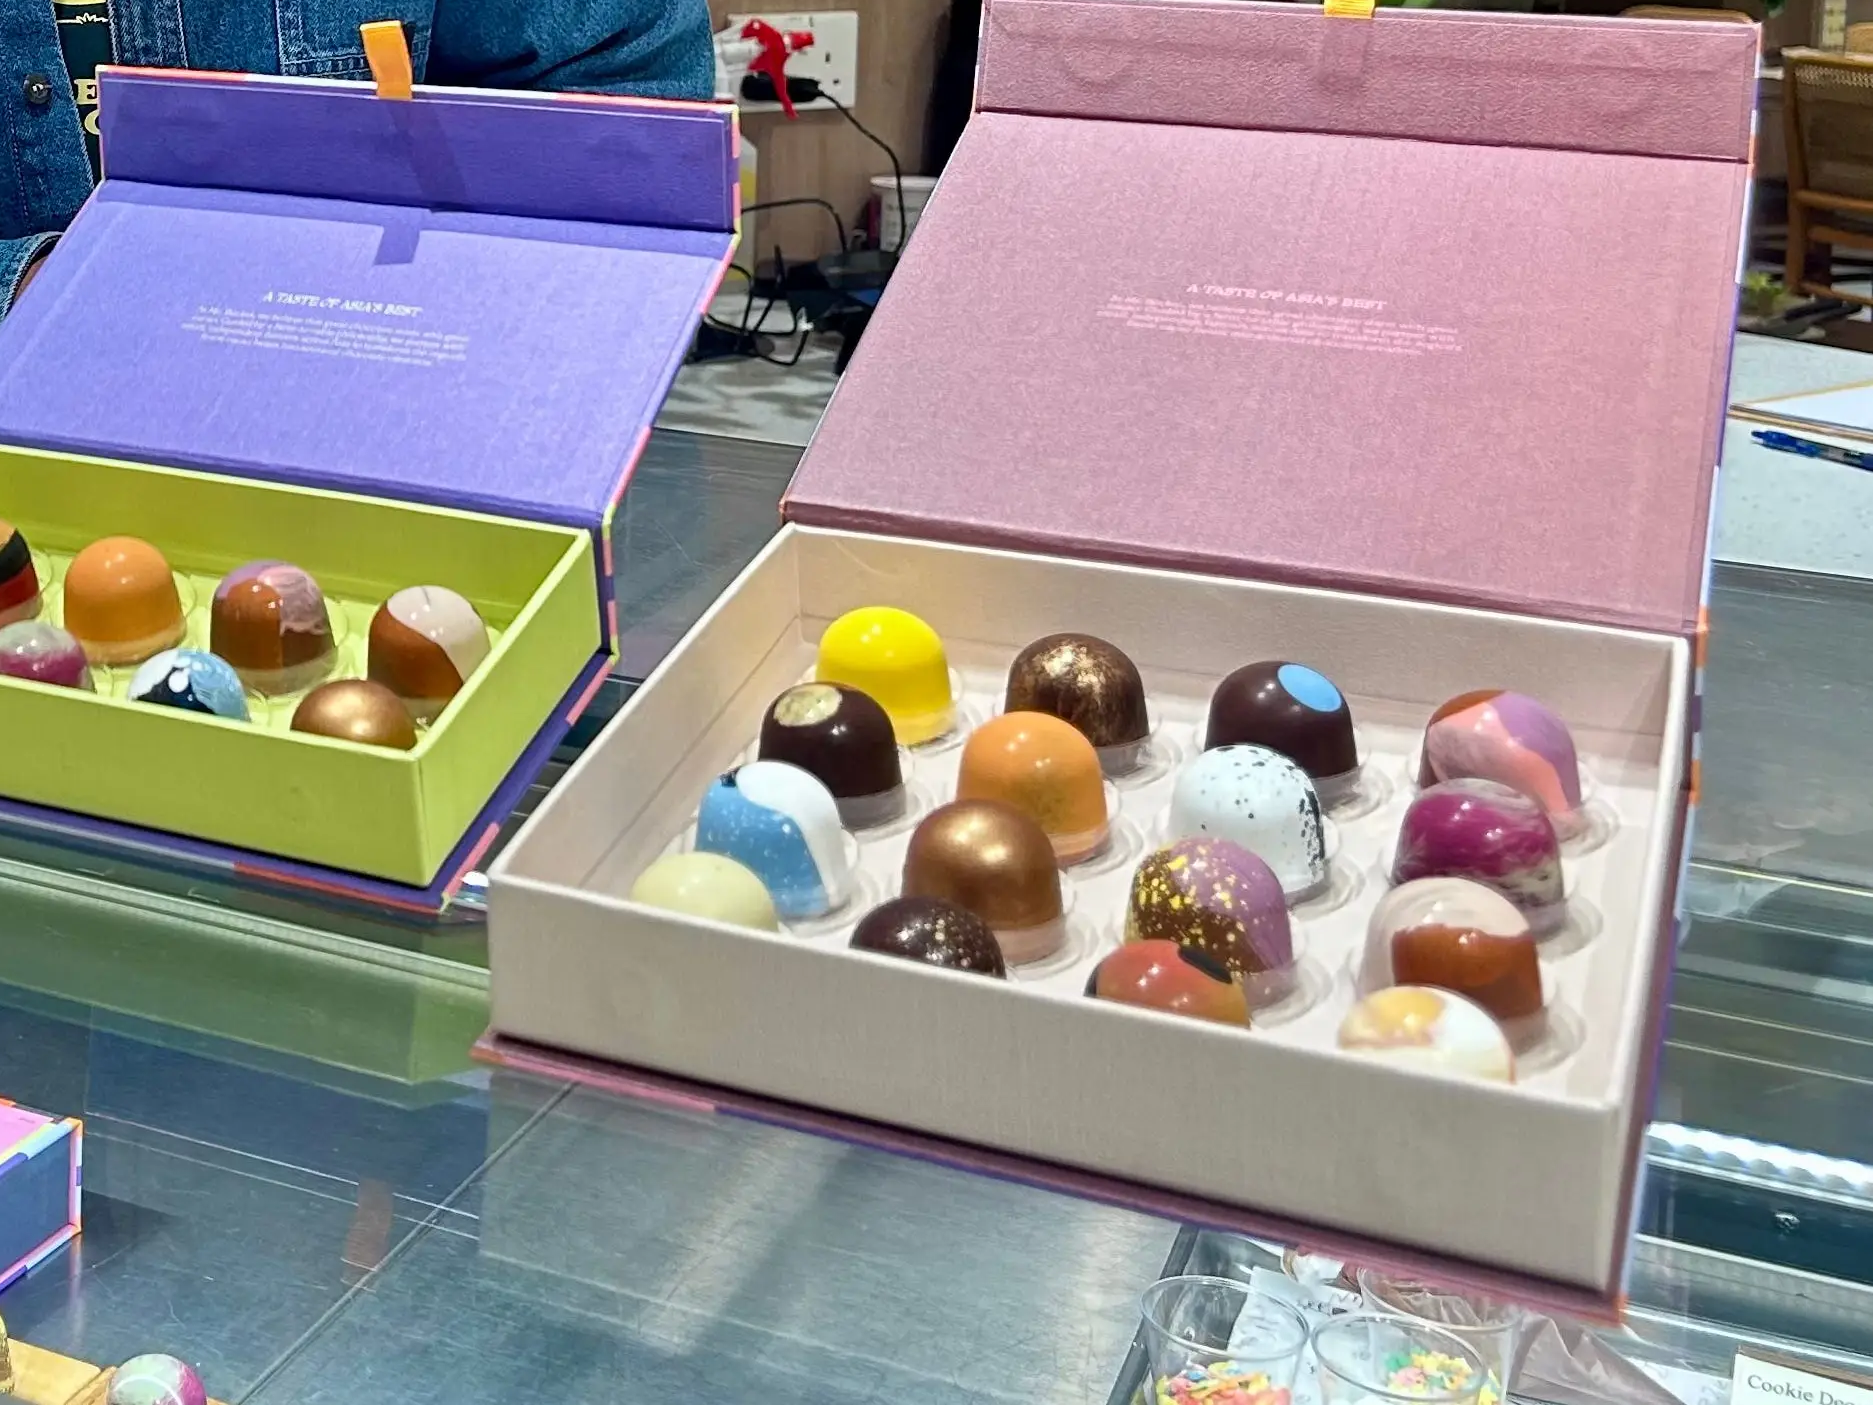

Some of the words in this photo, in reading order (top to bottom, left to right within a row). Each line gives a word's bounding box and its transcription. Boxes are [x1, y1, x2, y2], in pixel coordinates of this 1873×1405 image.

[262, 290, 274, 304] A
[276, 291, 318, 308] TASTE
[1186, 282, 1199, 294] A
[1202, 284, 1256, 300] TASTE
[1341, 297, 1388, 311] BEST
[1747, 1374, 1814, 1403] Cookie
